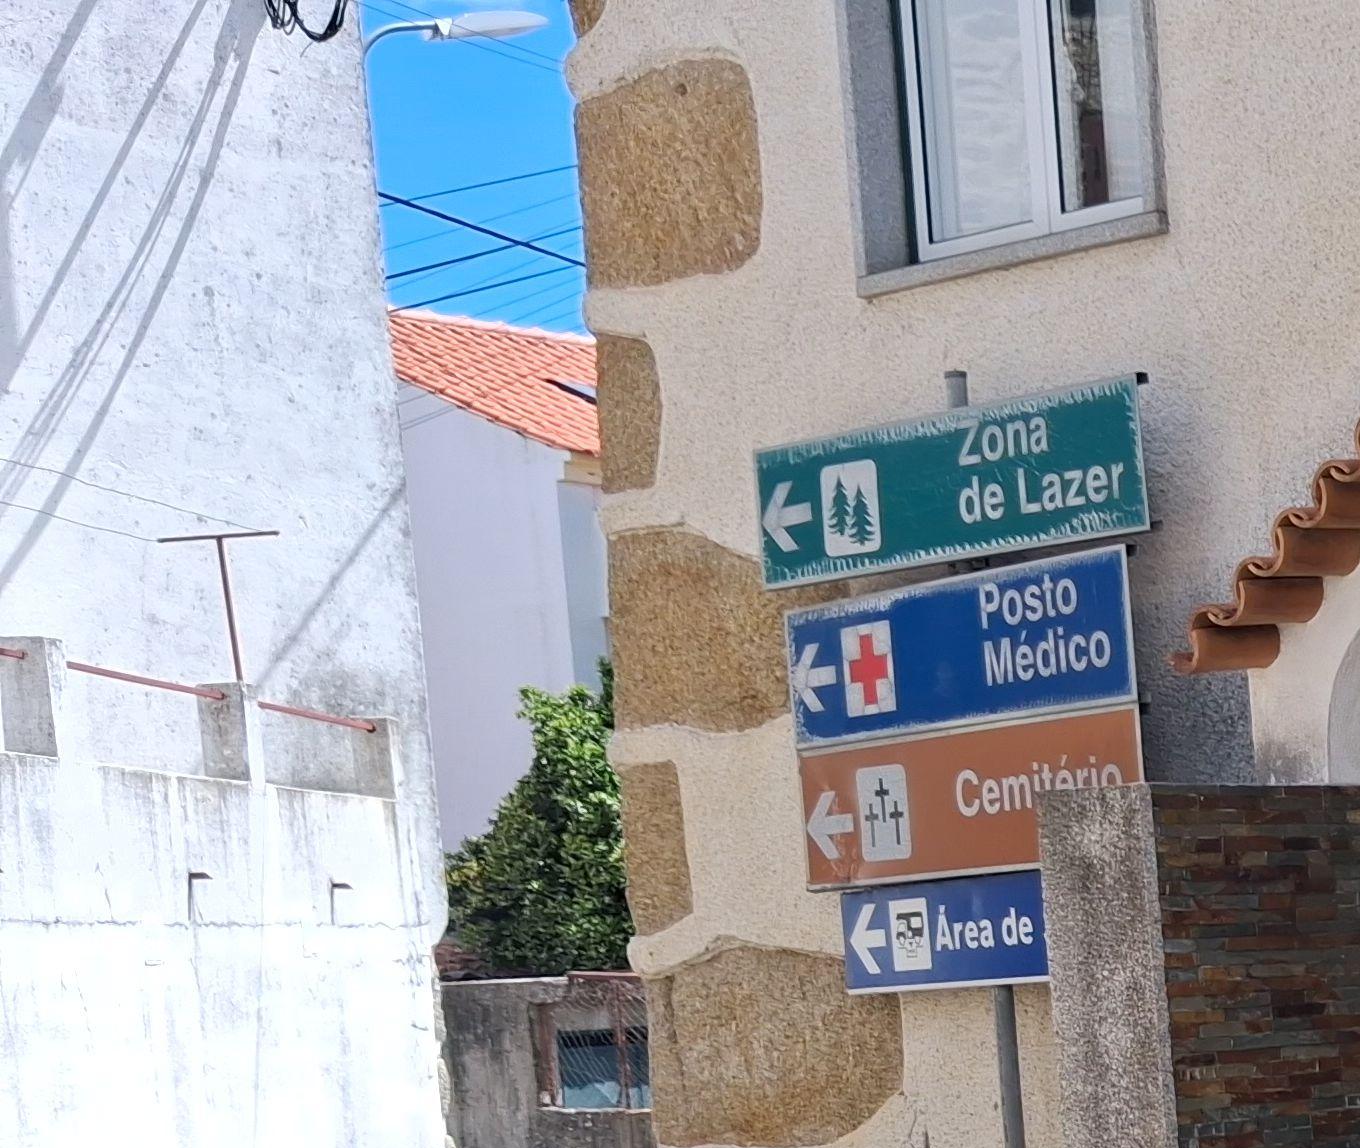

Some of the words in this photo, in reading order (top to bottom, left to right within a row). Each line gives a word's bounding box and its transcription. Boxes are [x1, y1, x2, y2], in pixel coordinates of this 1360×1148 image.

[957, 415, 1049, 467] Zona
[959, 476, 1005, 525] de
[1018, 462, 1125, 516] Lazer
[980, 575, 1078, 630] Posto
[983, 629, 1111, 687] Médico
[936, 905, 995, 951] Área
[1001, 907, 1034, 946] de
